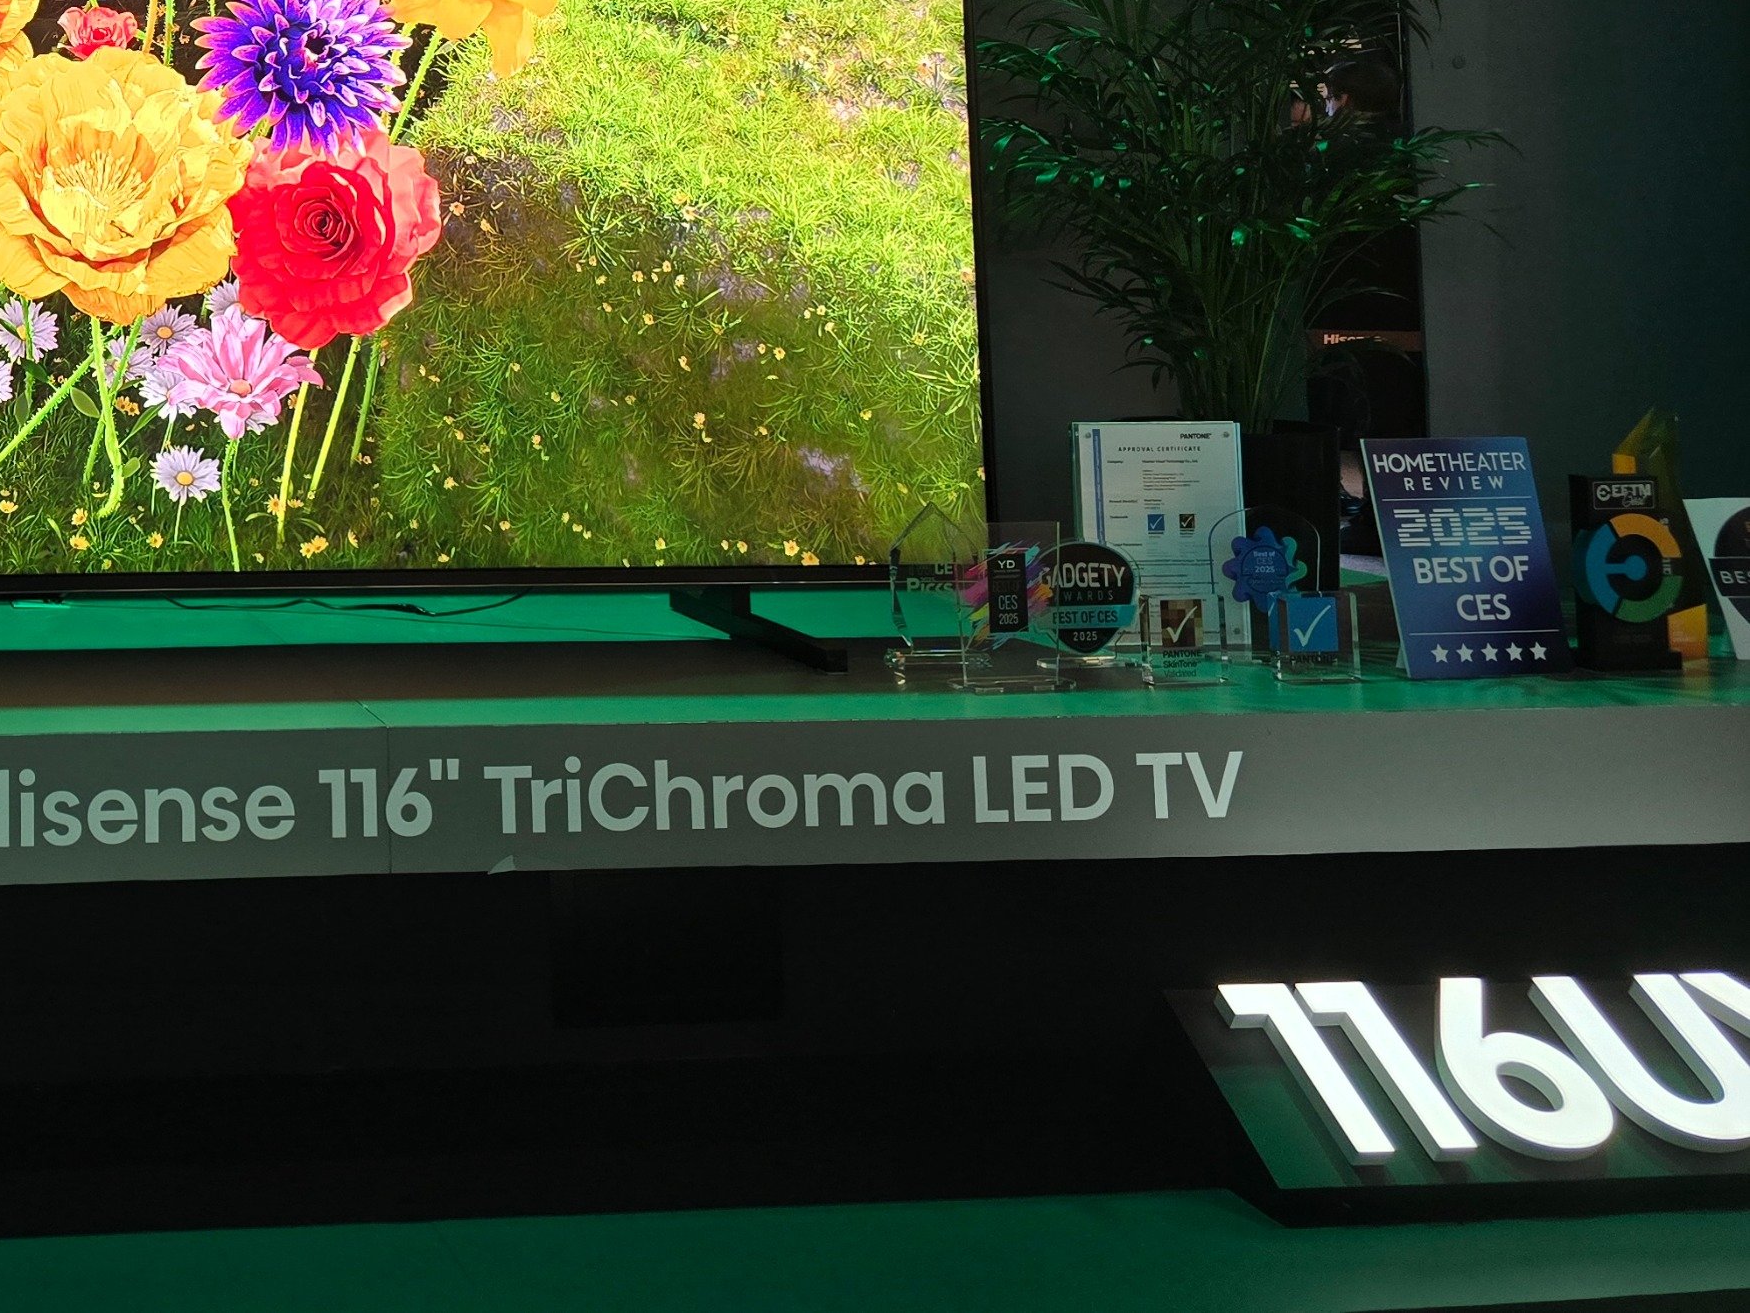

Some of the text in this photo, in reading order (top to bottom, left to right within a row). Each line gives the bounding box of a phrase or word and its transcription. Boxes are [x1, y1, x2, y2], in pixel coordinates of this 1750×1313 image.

[1404, 475, 1504, 491] REVIEW
[1393, 507, 1532, 547] 2025
[997, 560, 1016, 569] YD
[1413, 555, 1529, 584] BEST OF
[1038, 562, 1126, 589] GADGETY
[1720, 570, 1750, 585] BE
[998, 595, 1018, 611] CES
[1456, 594, 1511, 621] CES
[998, 612, 1019, 625] 2025
[1052, 608, 1118, 624] BEST OF CES
[1073, 630, 1098, 642] 2025
[1162, 650, 1203, 658] PANTONE
[318, 758, 460, 839] 116"
[483, 755, 946, 834] TriChroma
[972, 753, 1115, 824] LED
[1135, 750, 1244, 820] TV
[1214, 972, 1750, 1165] 116U
